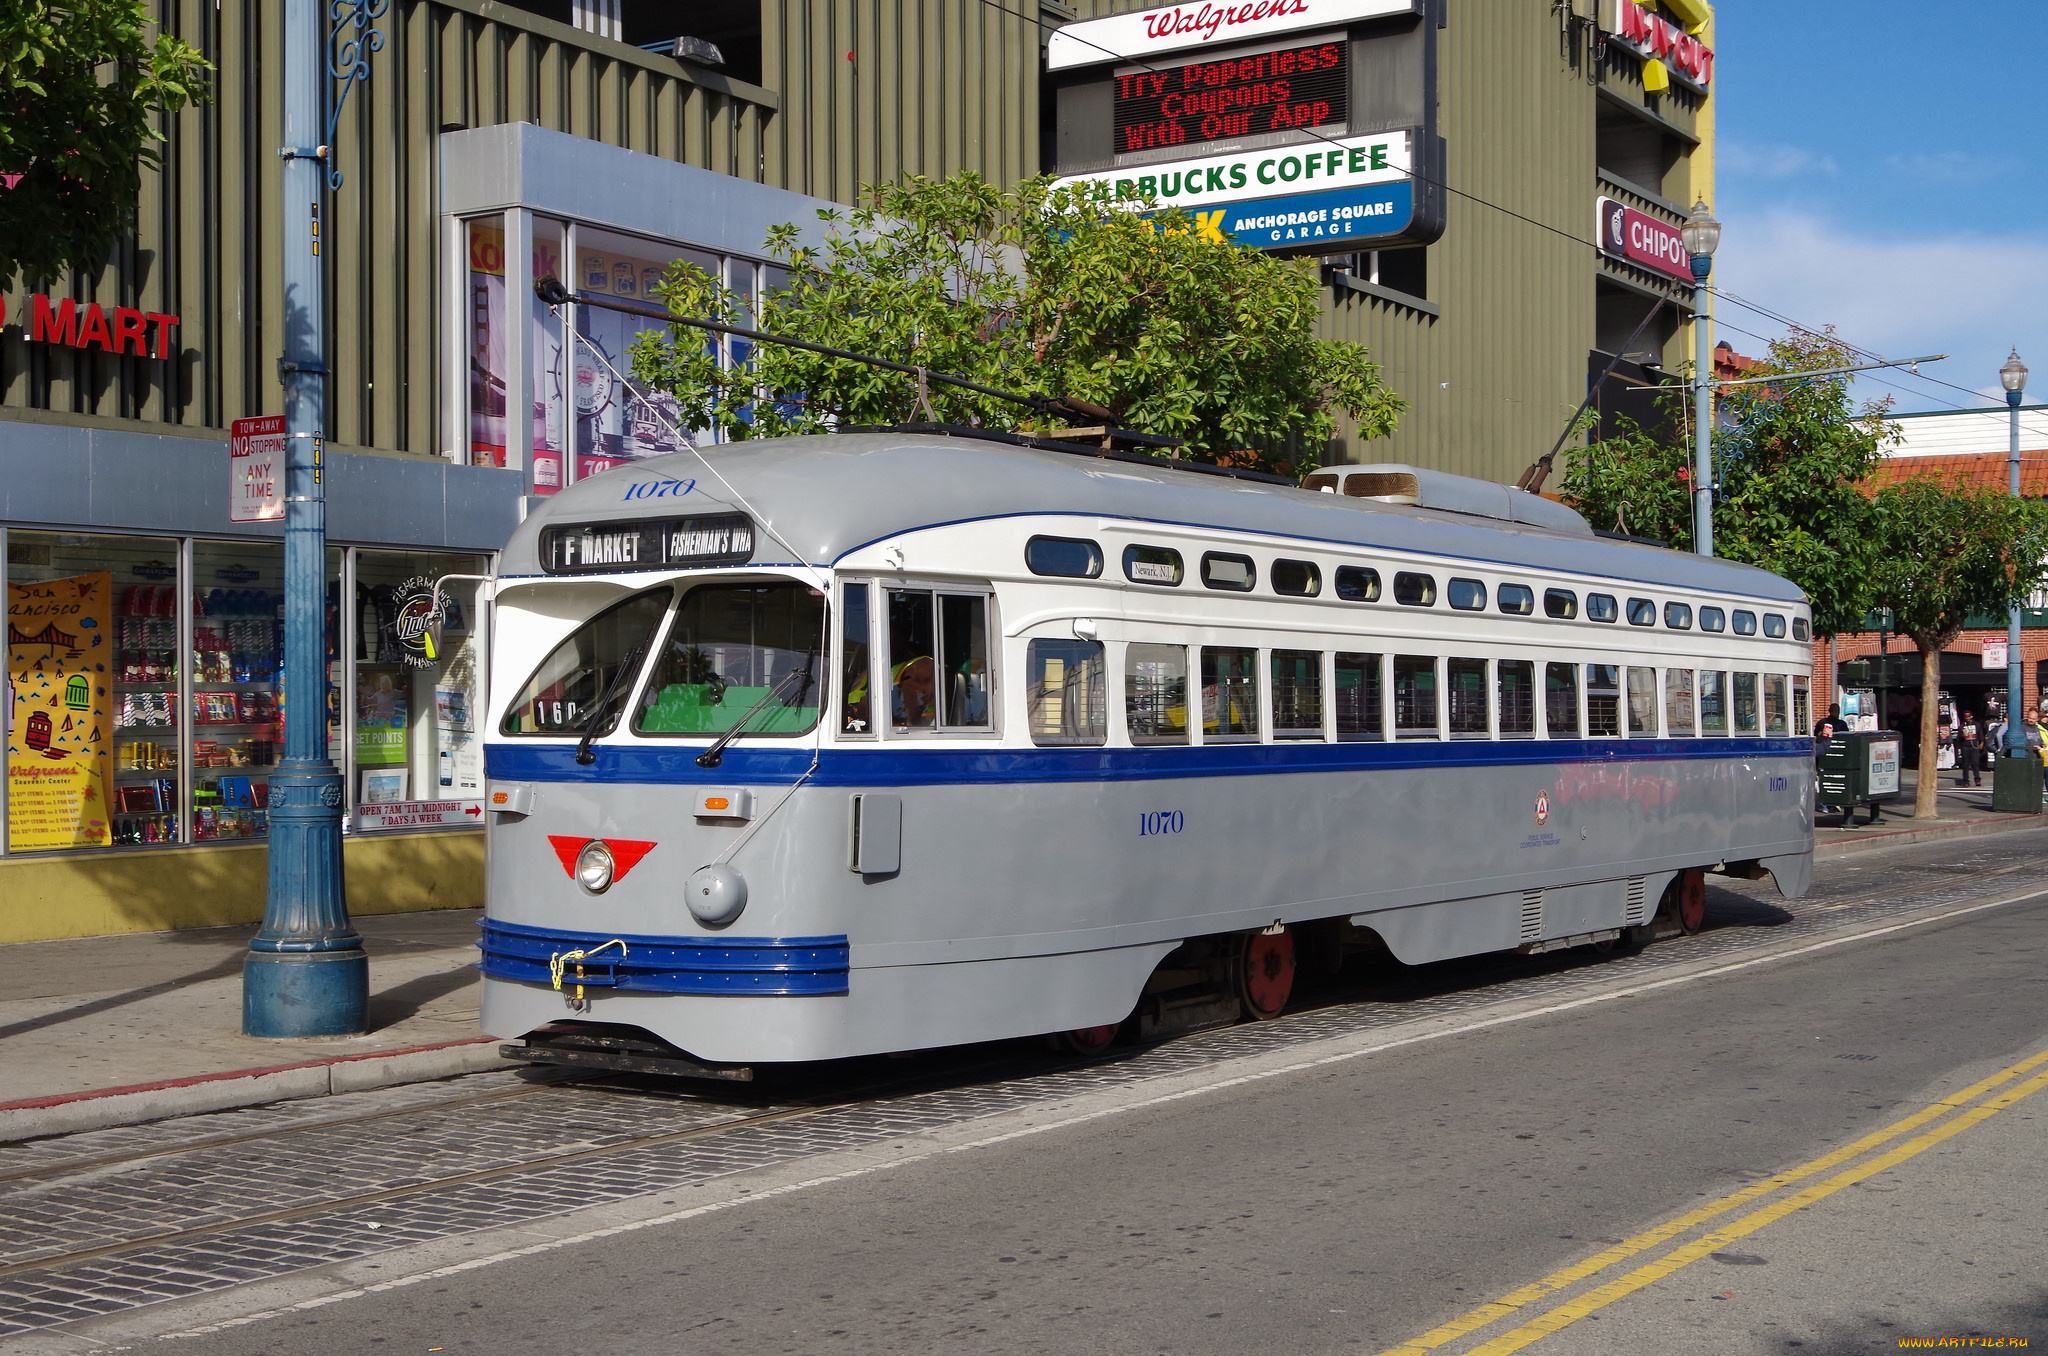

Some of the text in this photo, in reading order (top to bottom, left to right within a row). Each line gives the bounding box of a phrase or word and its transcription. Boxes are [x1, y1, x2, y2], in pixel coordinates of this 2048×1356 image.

[1143, 0, 1309, 40] Walgreens
[1117, 45, 1338, 98] Try Paperless
[1161, 80, 1290, 118] Coupons
[1124, 101, 1329, 150] With Our App
[1257, 144, 1388, 185] COFFEE
[1235, 202, 1393, 231] ANCHORAGE SQUARE
[1271, 222, 1352, 241] GARAGE
[1631, 222, 1690, 269] CHIPOT
[34, 294, 179, 360] MART
[240, 420, 280, 433] TOW-AWAY
[233, 436, 286, 455] NO STOPPING
[247, 464, 271, 479] ANY
[245, 483, 272, 498] TIME
[622, 479, 696, 501] 1070
[566, 537, 574, 565] F
[581, 532, 640, 564] MARKET
[671, 529, 729, 556] FISHERMAN'S
[16, 586, 55, 599] San
[392, 576, 451, 608] FISHERMN'S
[8, 601, 81, 615] ancisco
[372, 732, 403, 743] POINTS
[9, 766, 78, 780] Walgreens
[1770, 777, 1787, 791] 1070
[361, 806, 381, 816] OPEN
[385, 805, 401, 814] 7AM
[422, 803, 461, 812] MIDNIGHT
[382, 814, 442, 825] 7 DAYS A WEEK
[1139, 810, 1183, 836] 1070
